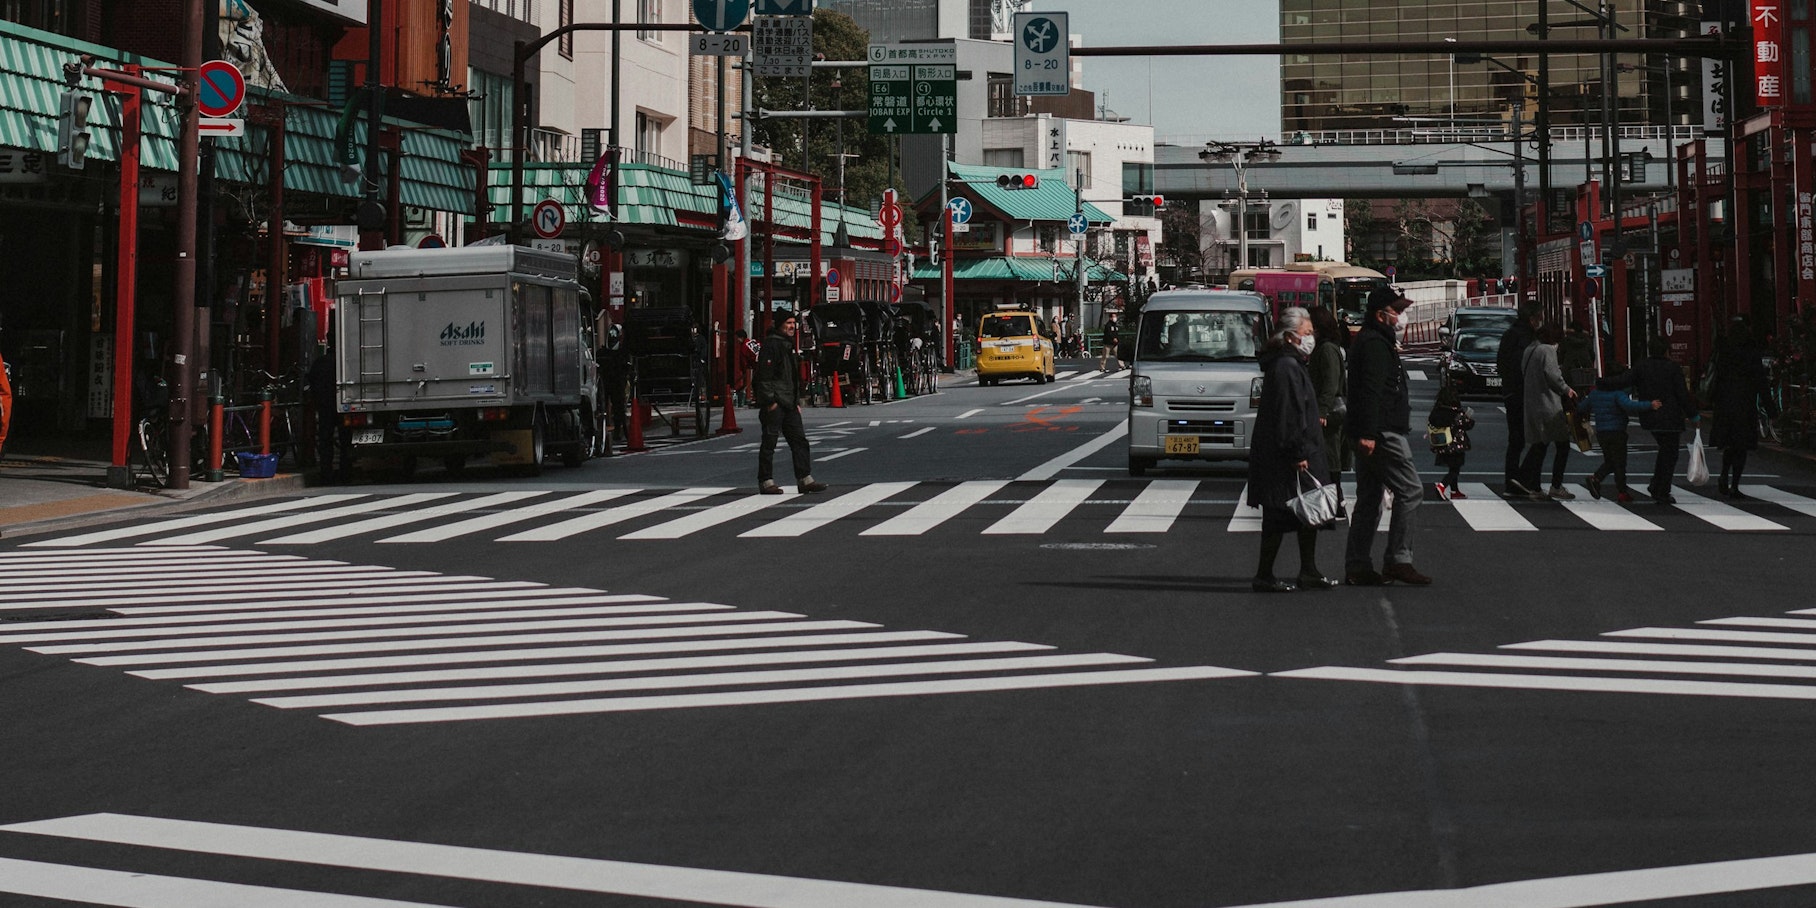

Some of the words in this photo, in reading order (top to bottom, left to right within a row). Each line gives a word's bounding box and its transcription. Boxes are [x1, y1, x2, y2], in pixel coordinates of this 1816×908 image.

[761, 19, 806, 28] 路線バス
[875, 49, 882, 59] 6
[889, 49, 917, 59] 首都高
[1754, 5, 1780, 98] 不動産
[760, 66, 805, 75] ここまで
[873, 68, 907, 79] 向島入口
[918, 68, 952, 79] 駒形入口
[875, 84, 887, 93] E6
[918, 84, 929, 93] C1
[872, 96, 907, 107] 常磐道
[916, 96, 954, 107] 都心環状
[869, 107, 894, 117] JOBAN
[896, 107, 910, 116] EXP
[917, 107, 944, 116] Circle
[947, 107, 953, 116] 1
[440, 320, 485, 340] Asahi
